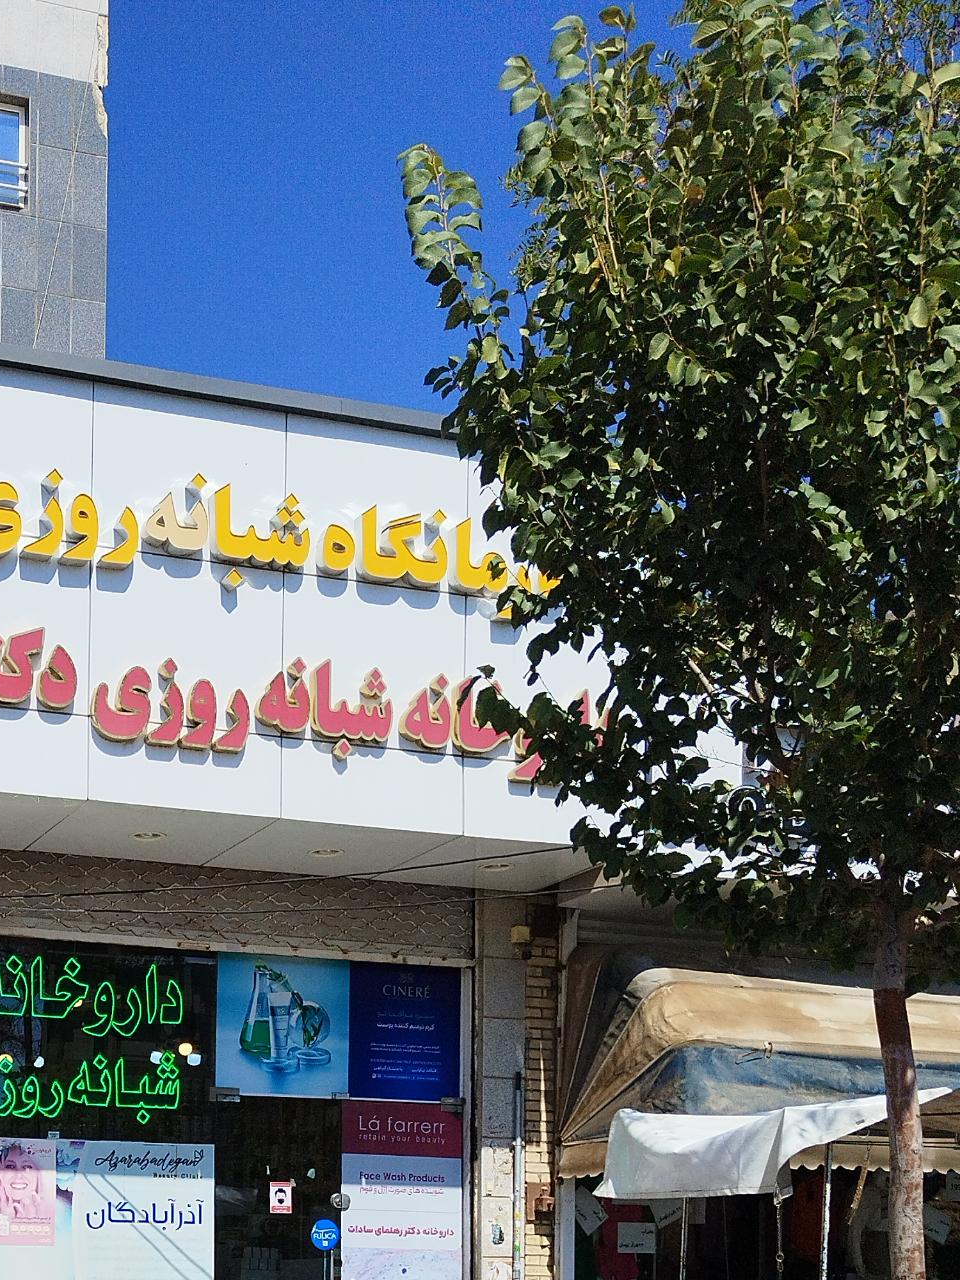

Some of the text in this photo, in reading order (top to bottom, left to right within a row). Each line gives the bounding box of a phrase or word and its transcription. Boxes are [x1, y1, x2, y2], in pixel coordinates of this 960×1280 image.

[141, 472, 310, 592] شبانه
[91, 656, 250, 754] روزی
[255, 656, 393, 761] شبانه
[383, 985, 431, 998] CINERÉ
[67, 1051, 180, 1125] شبانه
[388, 1117, 445, 1134] farrerr
[359, 1171, 445, 1183] Face Wash Products
[347, 1225, 454, 1238] داروخانه دکتر رهنمای سادات
